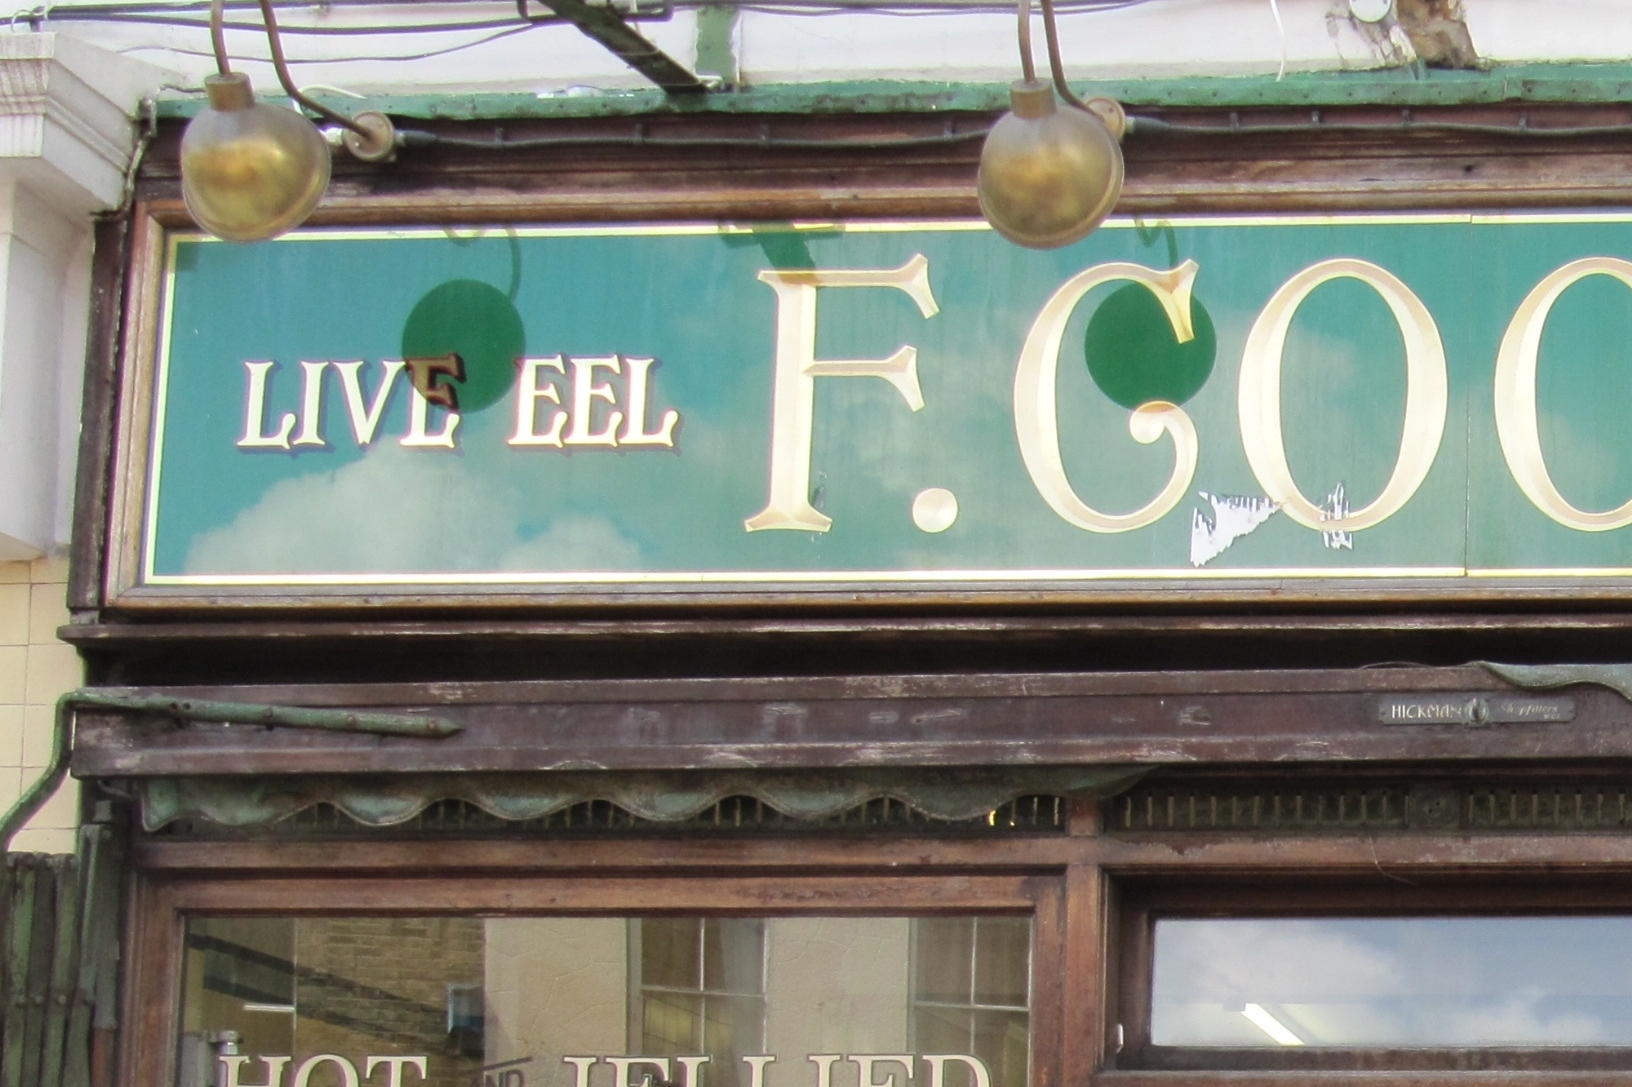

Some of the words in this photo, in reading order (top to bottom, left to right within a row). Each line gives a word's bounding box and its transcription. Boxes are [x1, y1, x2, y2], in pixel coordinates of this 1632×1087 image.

[236, 353, 464, 450] LIVE
[507, 354, 678, 450] EEL
[1500, 703, 1559, 716] Shpfitters
